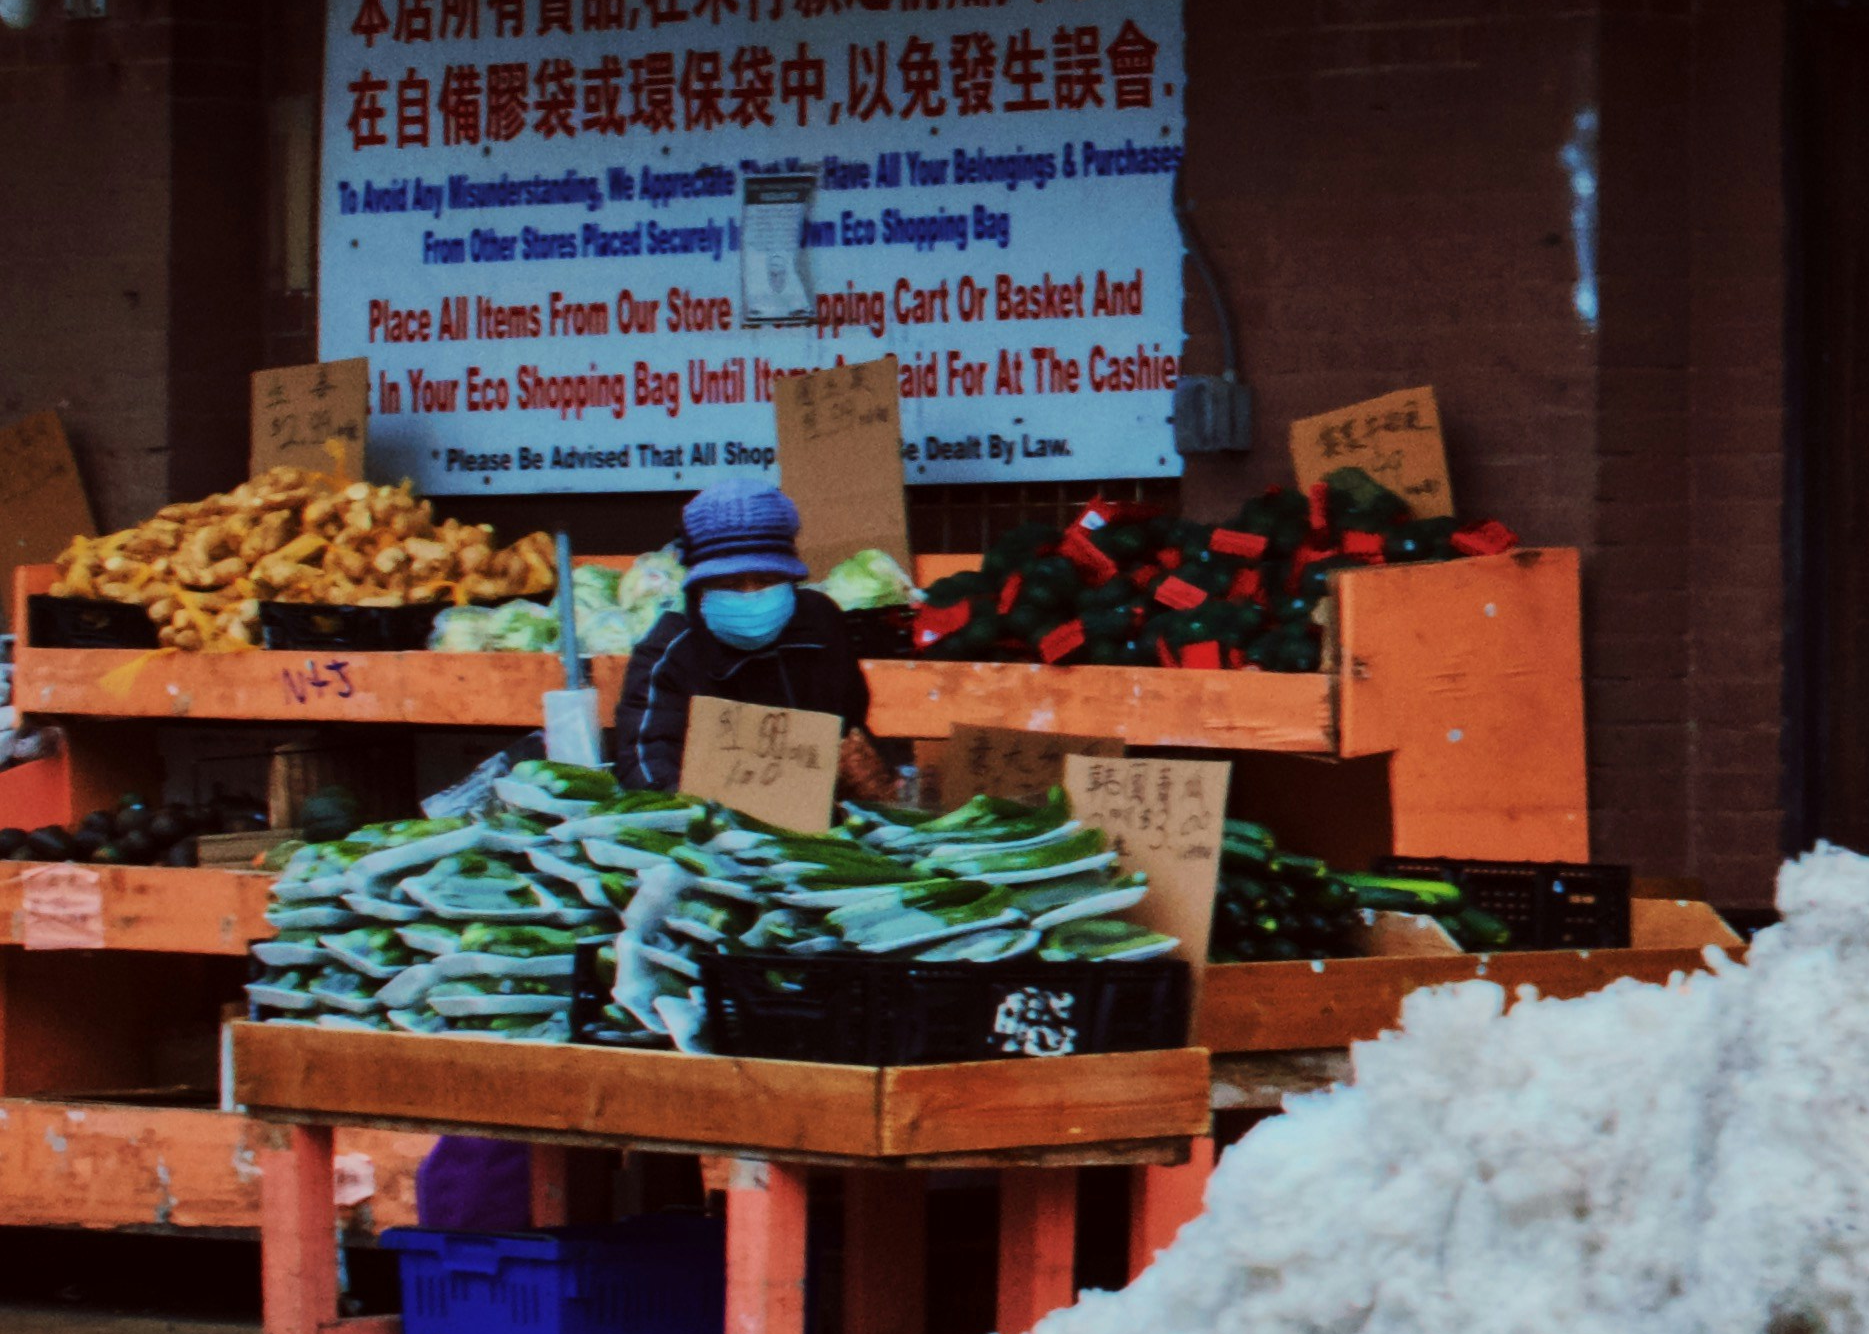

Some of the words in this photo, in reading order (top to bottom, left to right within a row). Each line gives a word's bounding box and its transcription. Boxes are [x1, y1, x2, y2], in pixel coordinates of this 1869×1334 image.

[339, 181, 357, 214] To
[363, 179, 408, 212] Avoid
[413, 177, 443, 219] Any
[607, 166, 634, 202] We
[640, 163, 735, 207] Appreciate
[876, 151, 901, 188] All
[906, 150, 949, 185] Your
[954, 145, 1057, 191] Belongings
[1063, 142, 1077, 177] &
[1083, 139, 1182, 176] Purchases
[423, 230, 465, 264] From
[470, 227, 517, 262] Other
[522, 225, 577, 259] Stores
[582, 222, 641, 257] Placed
[647, 217, 724, 261] Securely
[841, 210, 876, 246] Eco
[882, 206, 968, 251] Shopping
[973, 204, 1010, 248] Bag
[369, 299, 430, 343] Place
[438, 296, 468, 341] All
[477, 295, 541, 338] Items
[549, 291, 608, 336] From
[618, 289, 659, 334] Our
[667, 287, 731, 332] Store
[815, 280, 885, 339] pping
[894, 277, 948, 325] Cart
[957, 275, 988, 323] Or
[995, 272, 1085, 320] Basket
[1092, 269, 1143, 317] And
[379, 370, 400, 415] In
[408, 368, 458, 413] Your
[467, 366, 508, 411] Eco
[517, 363, 625, 419] Shopping
[635, 361, 679, 417] Bag
[688, 357, 745, 404] Until
[900, 352, 937, 399] aid
[947, 350, 987, 396] For
[997, 348, 1023, 395] At
[1031, 346, 1079, 393] The
[446, 447, 511, 471] Please
[519, 446, 543, 470] Be
[551, 444, 629, 469] Advised
[637, 443, 683, 468] That
[690, 442, 717, 467] All
[925, 435, 979, 462] Dealt
[989, 434, 1015, 464] By
[1022, 433, 1073, 459] Law.
